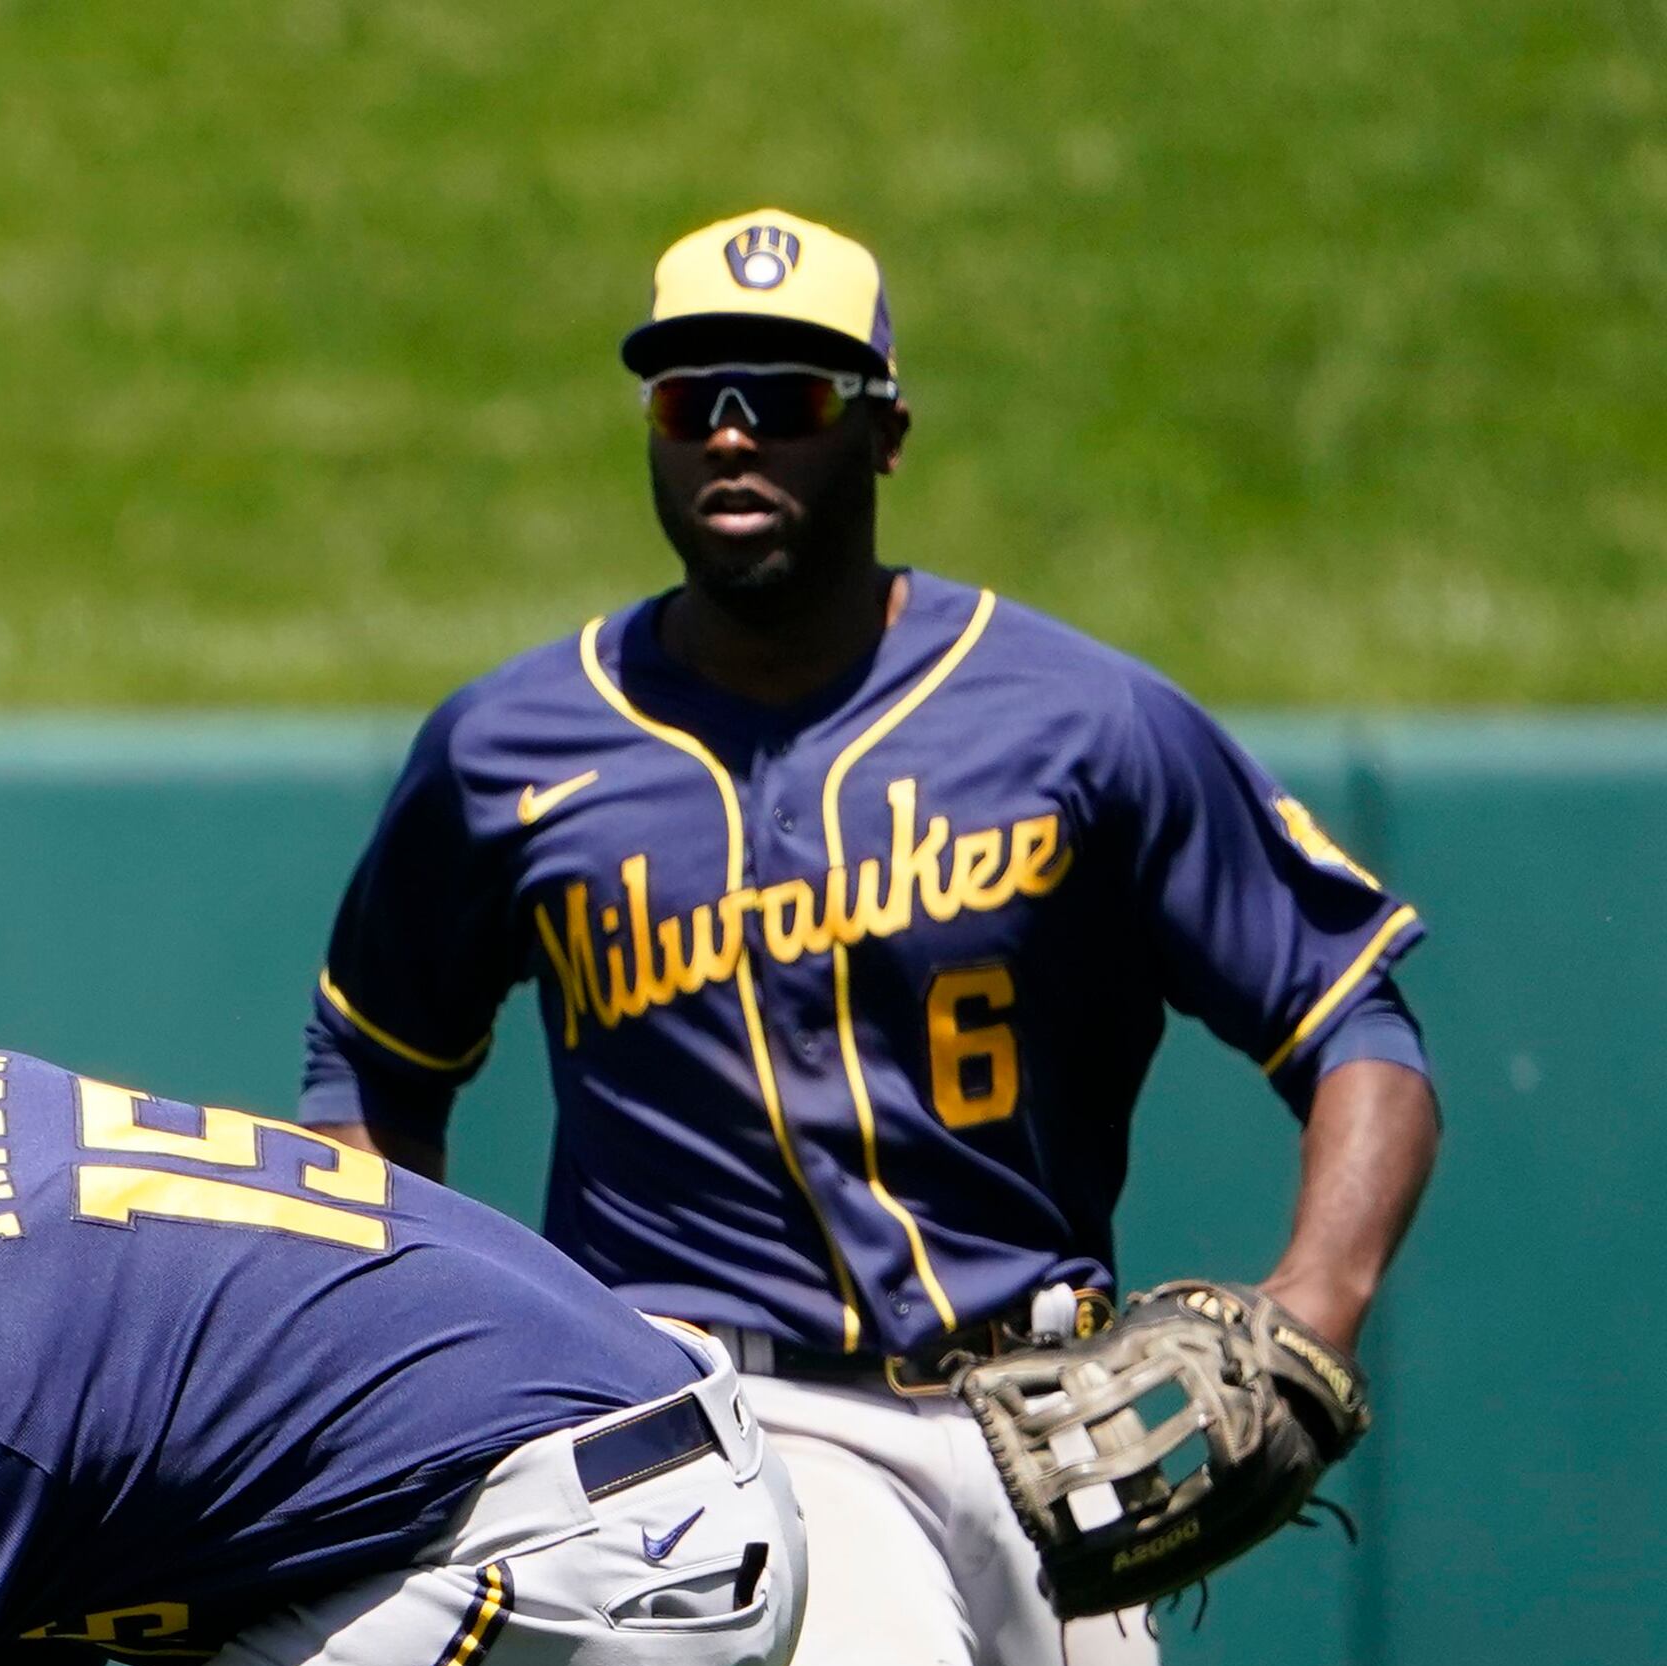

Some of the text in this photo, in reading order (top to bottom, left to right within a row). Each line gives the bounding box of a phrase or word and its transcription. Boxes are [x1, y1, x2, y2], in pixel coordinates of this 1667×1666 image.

[533, 778, 1073, 1050] Milwaukee
[926, 962, 1020, 1130] 6
[70, 1074, 394, 1255] 15
